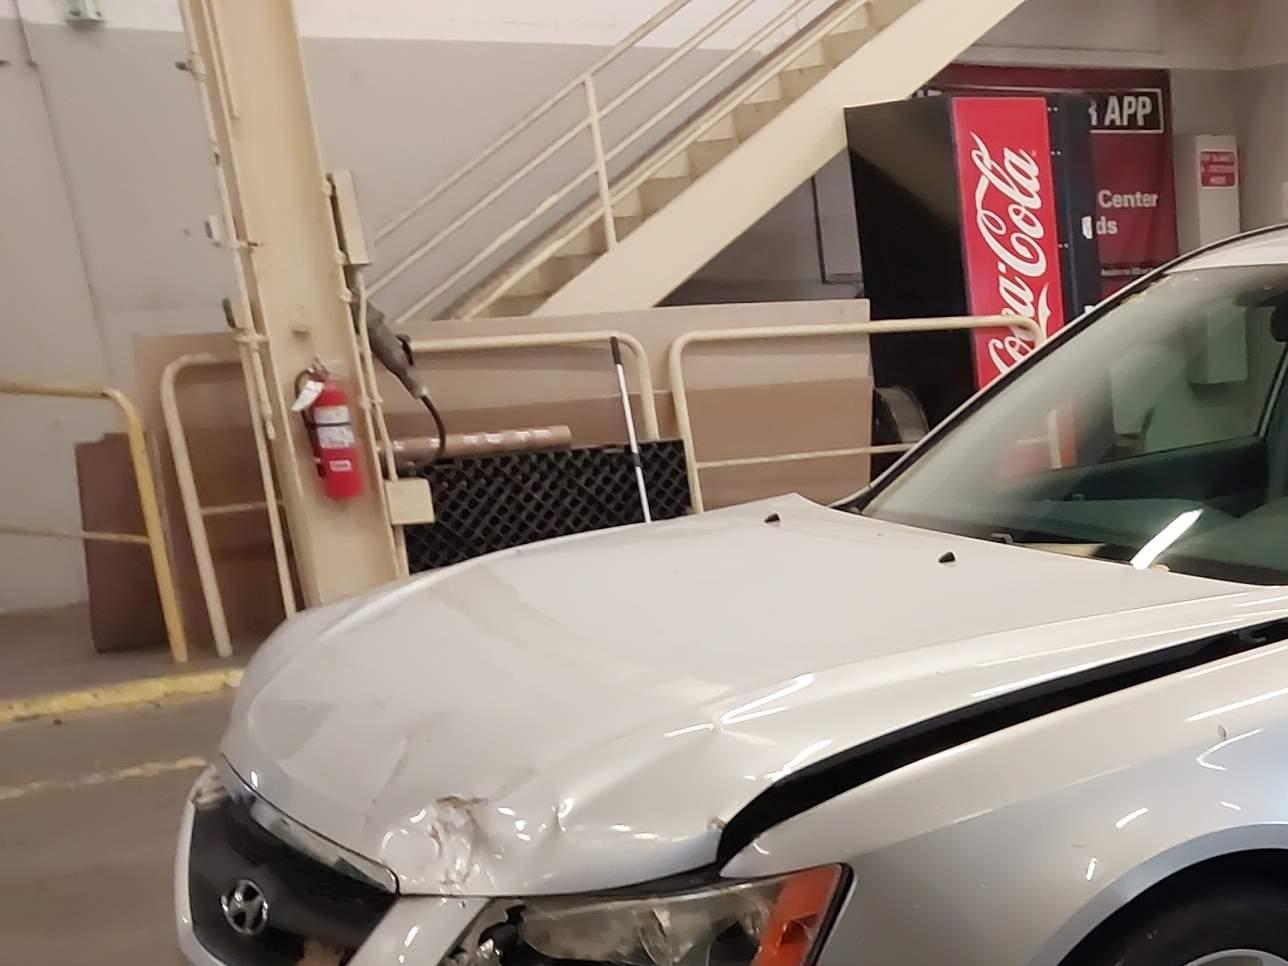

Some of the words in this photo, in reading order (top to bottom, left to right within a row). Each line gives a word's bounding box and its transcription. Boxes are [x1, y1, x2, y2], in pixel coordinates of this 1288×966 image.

[1104, 95, 1153, 126] APP
[1098, 189, 1159, 208] Center
[1096, 215, 1118, 235] ds
